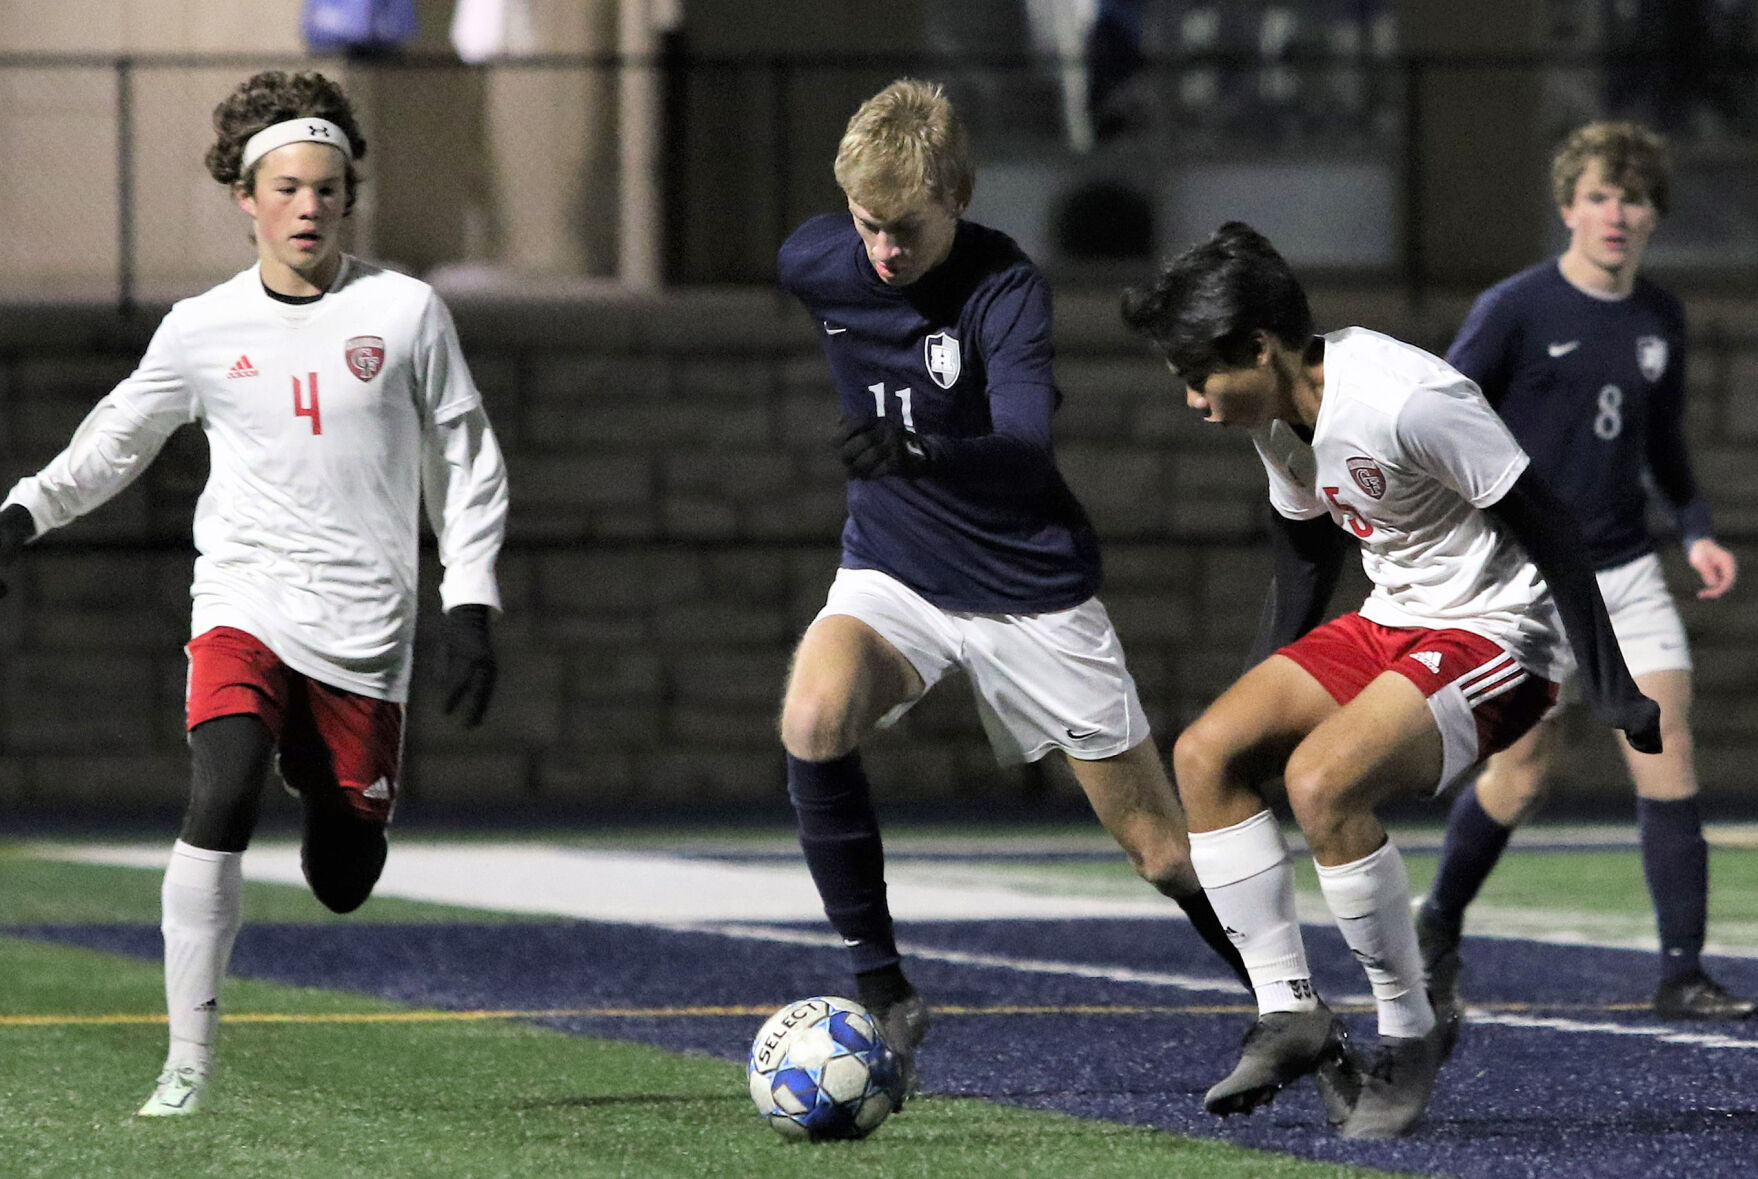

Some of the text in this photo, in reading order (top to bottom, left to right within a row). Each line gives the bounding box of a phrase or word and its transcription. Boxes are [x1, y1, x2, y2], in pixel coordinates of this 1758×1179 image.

[293, 372, 322, 435] 4
[868, 382, 916, 433] 11
[1595, 385, 1622, 439] 8
[1322, 487, 1373, 538] 5
[759, 1002, 817, 1064] SELECT
